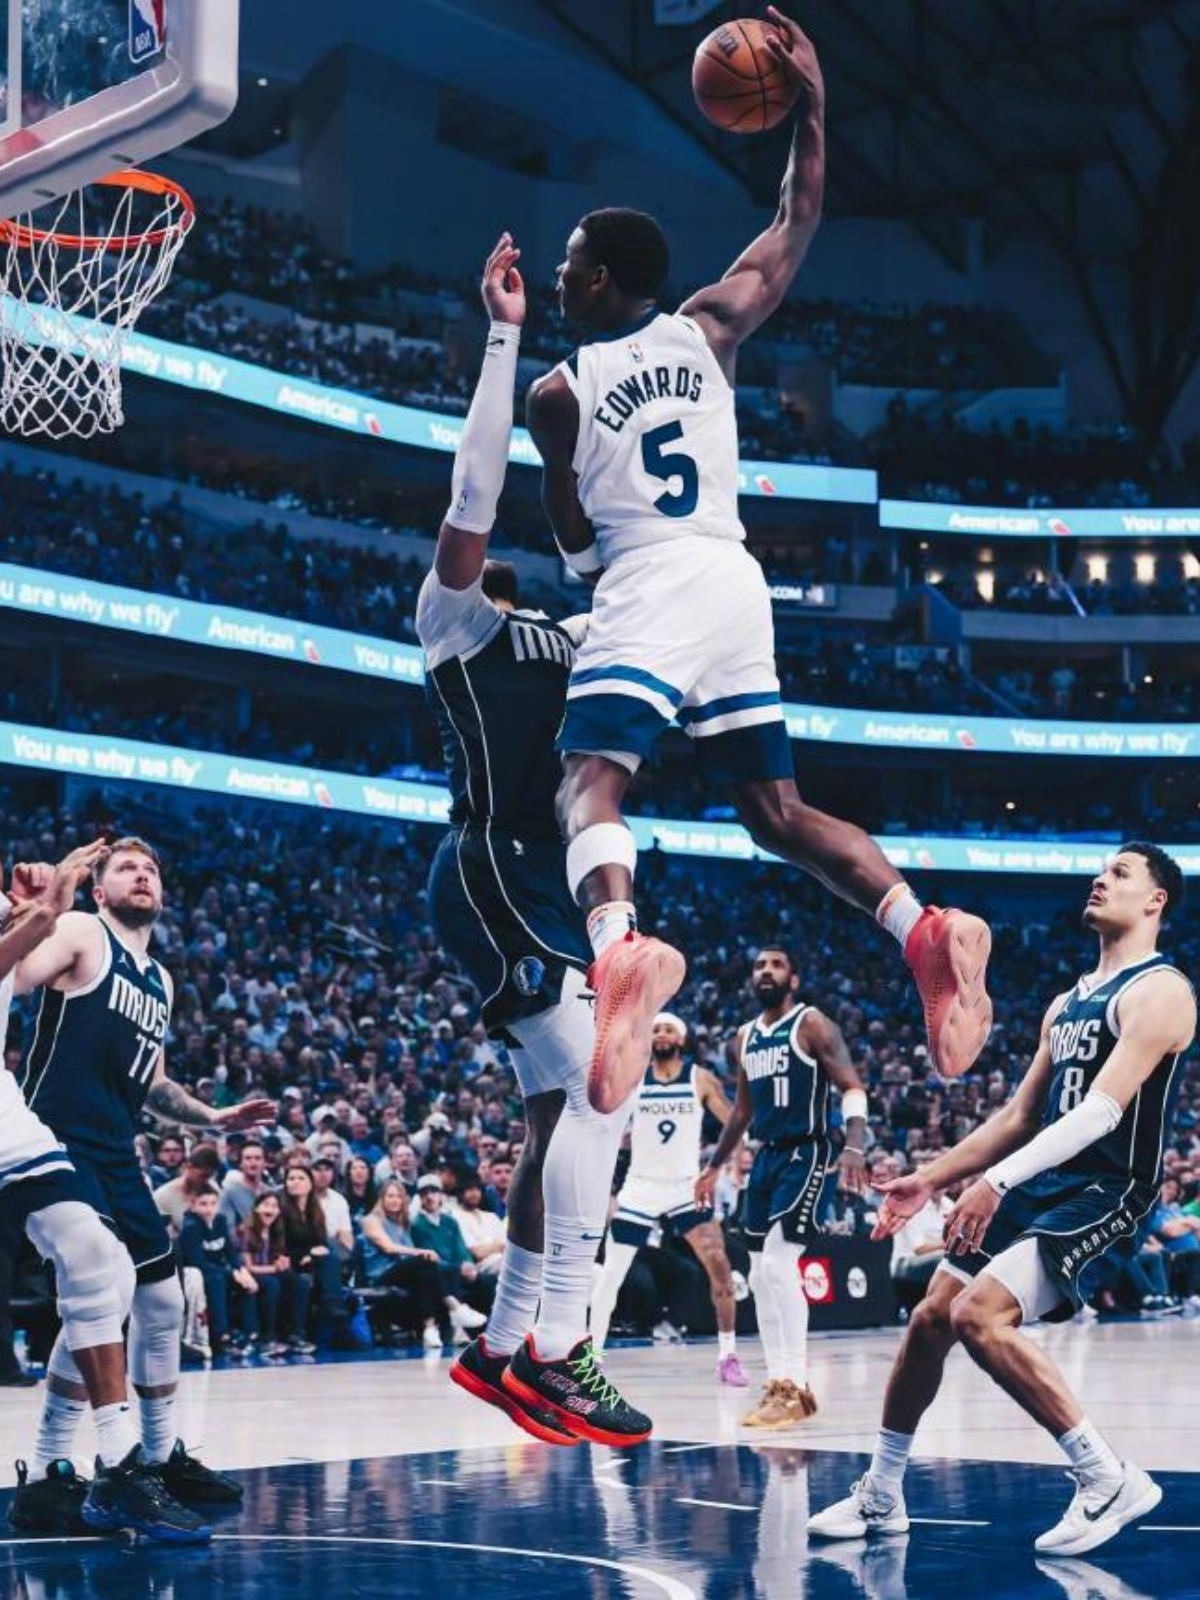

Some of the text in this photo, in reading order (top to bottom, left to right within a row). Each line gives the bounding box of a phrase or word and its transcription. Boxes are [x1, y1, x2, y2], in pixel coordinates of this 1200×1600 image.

[277, 385, 358, 425] American
[594, 366, 702, 433] EDWARDS
[641, 419, 699, 518] 5
[948, 512, 1039, 533] American
[1121, 515, 1162, 532] You
[18, 583, 56, 607] are
[60, 591, 104, 622] why
[109, 601, 141, 625] we
[208, 615, 296, 652] American
[354, 643, 421, 678] You are
[863, 720, 949, 743] American
[1010, 728, 1046, 748] You
[1050, 733, 1080, 749] are
[1083, 731, 1124, 755] why
[1127, 735, 1159, 751] we
[12, 733, 52, 762] You
[54, 744, 90, 768] are
[93, 749, 135, 778] why
[138, 756, 168, 778] we
[228, 767, 310, 798] American
[362, 784, 397, 811] You
[399, 794, 427, 816] are
[966, 847, 1001, 869] You
[108, 972, 169, 1039] MAVS
[128, 1032, 160, 1084] 77
[773, 1077, 789, 1107] 11
[1059, 1067, 1084, 1114] 8
[639, 1102, 695, 1115] WOLVES
[658, 1120, 676, 1144] 9
